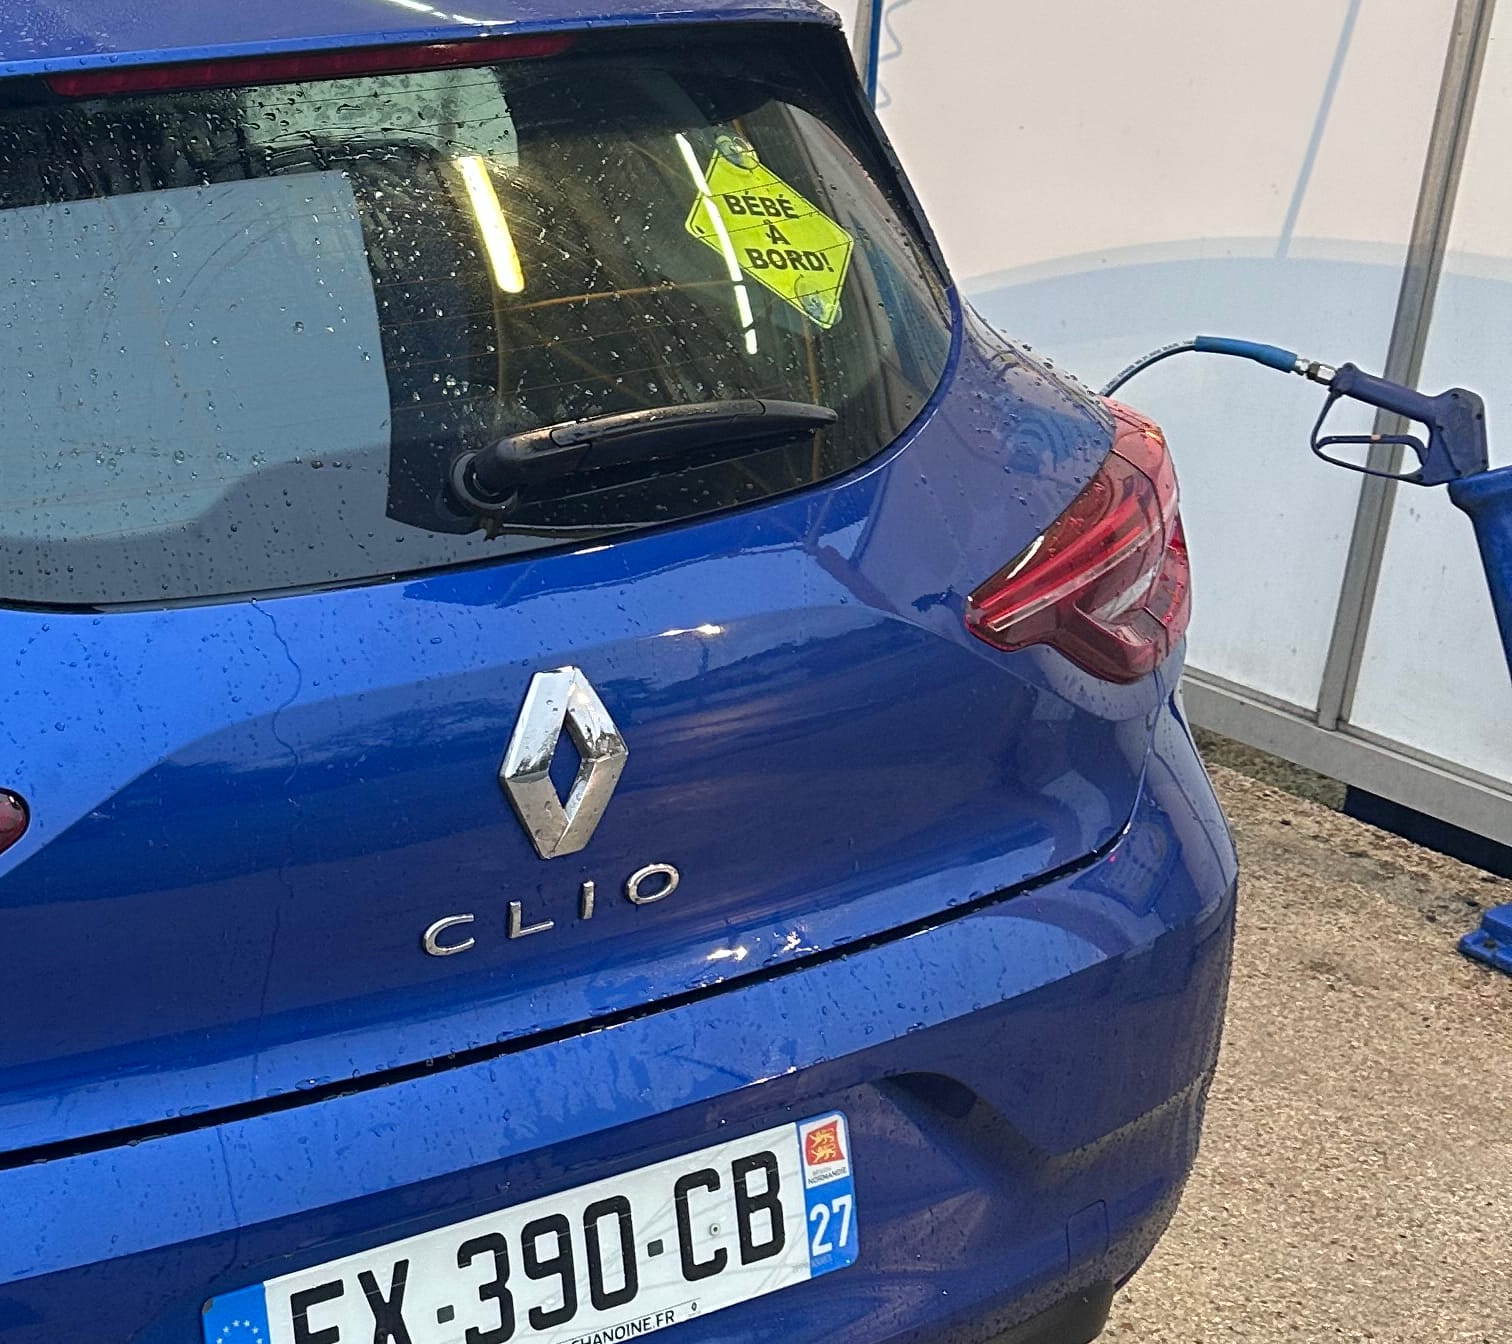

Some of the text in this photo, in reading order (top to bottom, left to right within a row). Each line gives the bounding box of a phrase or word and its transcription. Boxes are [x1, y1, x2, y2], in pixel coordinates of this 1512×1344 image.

[722, 190, 799, 219] BÉBÉ
[744, 247, 835, 273] BORD!
[423, 863, 680, 957] CLIO
[809, 1194, 852, 1257] 27
